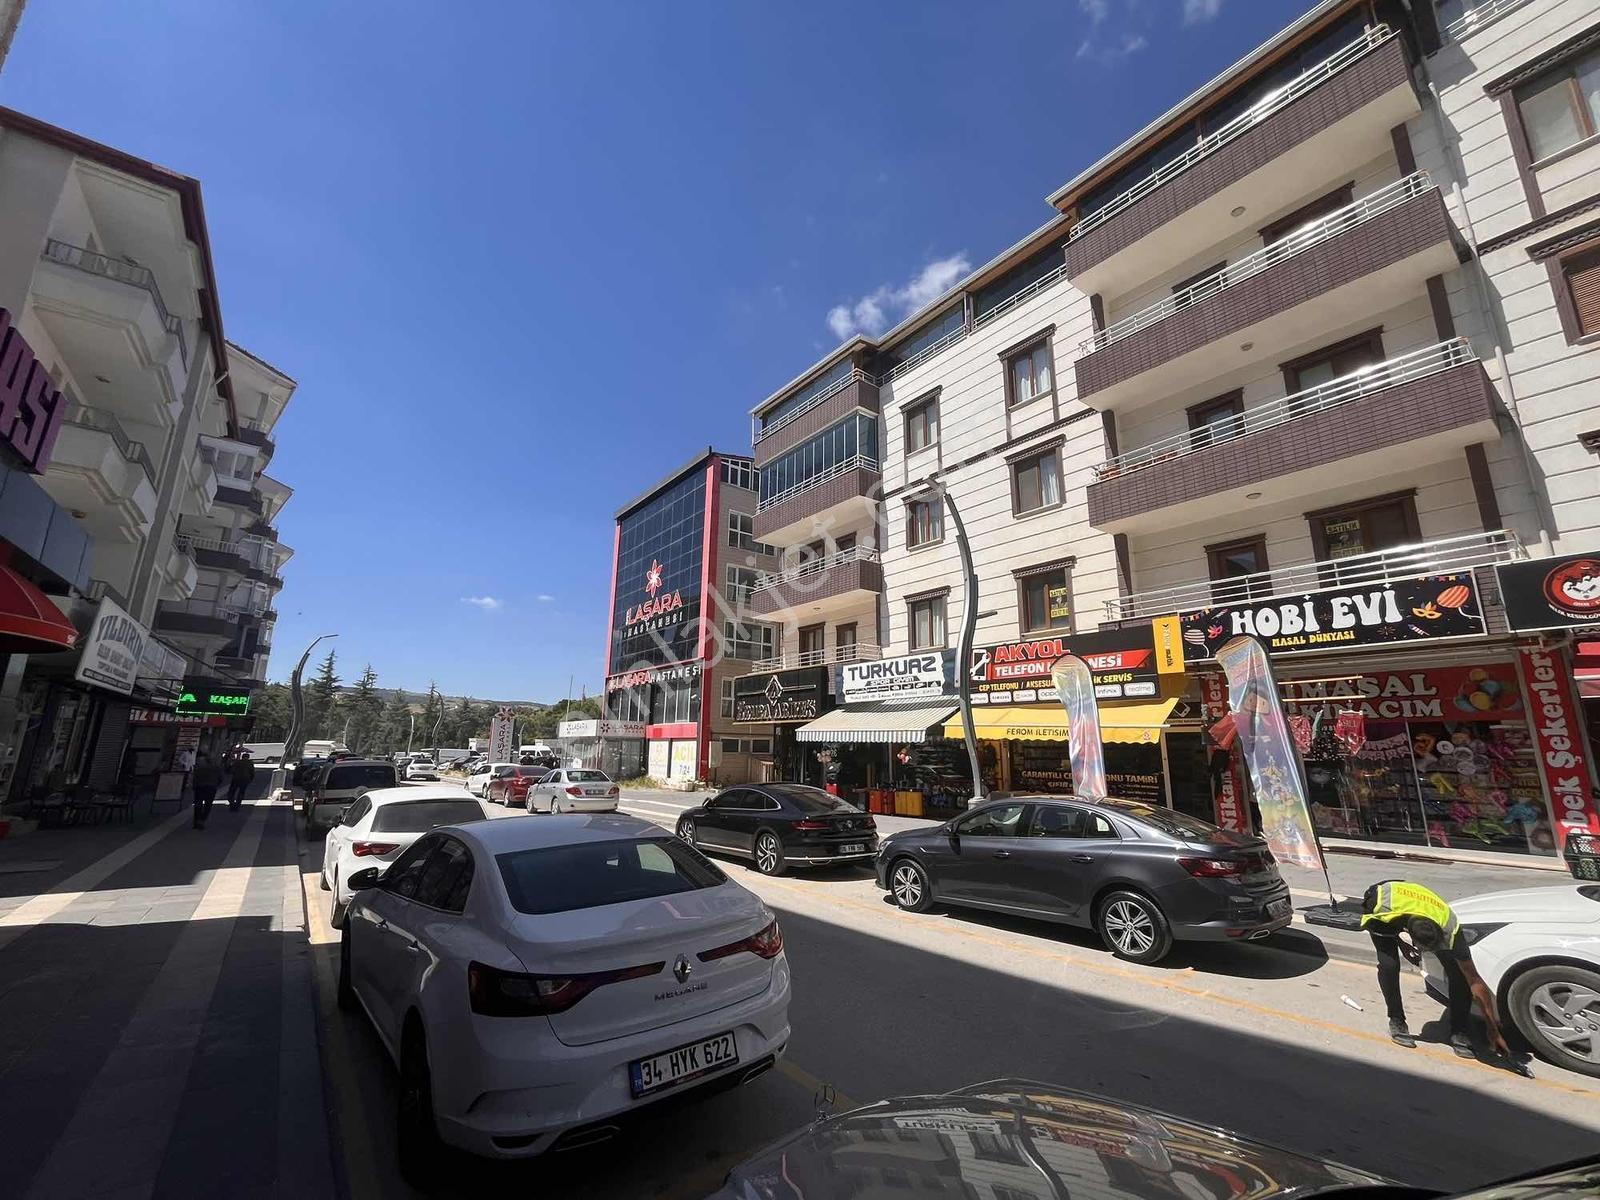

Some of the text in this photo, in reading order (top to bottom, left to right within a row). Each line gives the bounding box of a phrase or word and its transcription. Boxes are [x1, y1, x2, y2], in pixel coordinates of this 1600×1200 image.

[1271, 630, 1356, 648] MASAL DÜNYASI
[995, 639, 1071, 662] AKYOL
[848, 656, 937, 681] TURKUAZ
[994, 665, 1045, 679] TELEFON
[979, 684, 990, 692] CEP
[991, 681, 1019, 691] TELEFONU
[1026, 680, 1055, 689] AKSESUA
[1300, 674, 1438, 700] MASAL
[210, 694, 248, 706] KAŞAR
[1125, 773, 1158, 784] TAMİRİ
[642, 1060, 663, 1087] 34
[669, 1047, 700, 1078] HYK
[703, 1037, 732, 1063] 622
